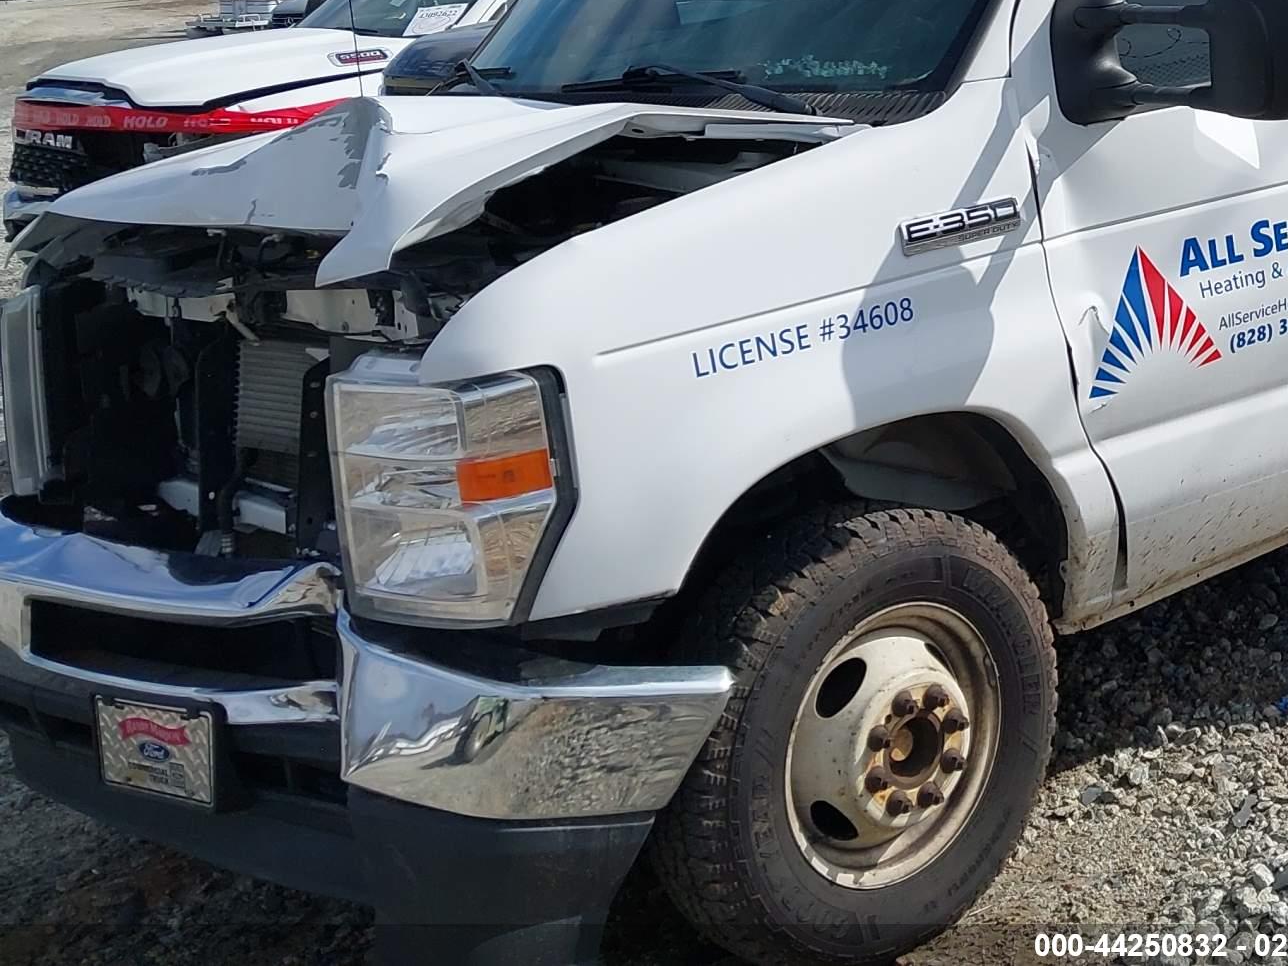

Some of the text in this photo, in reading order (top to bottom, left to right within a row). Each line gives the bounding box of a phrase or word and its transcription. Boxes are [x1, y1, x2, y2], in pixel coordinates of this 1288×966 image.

[124, 116, 168, 128] HOLD
[30, 130, 72, 149] RAM
[992, 221, 1020, 234] DUTY
[1179, 236, 1245, 278] ALL
[1198, 264, 1266, 300] Heating
[1271, 259, 1284, 279] &
[692, 297, 914, 378] LICENSE #34608
[1228, 322, 1275, 355] (828)
